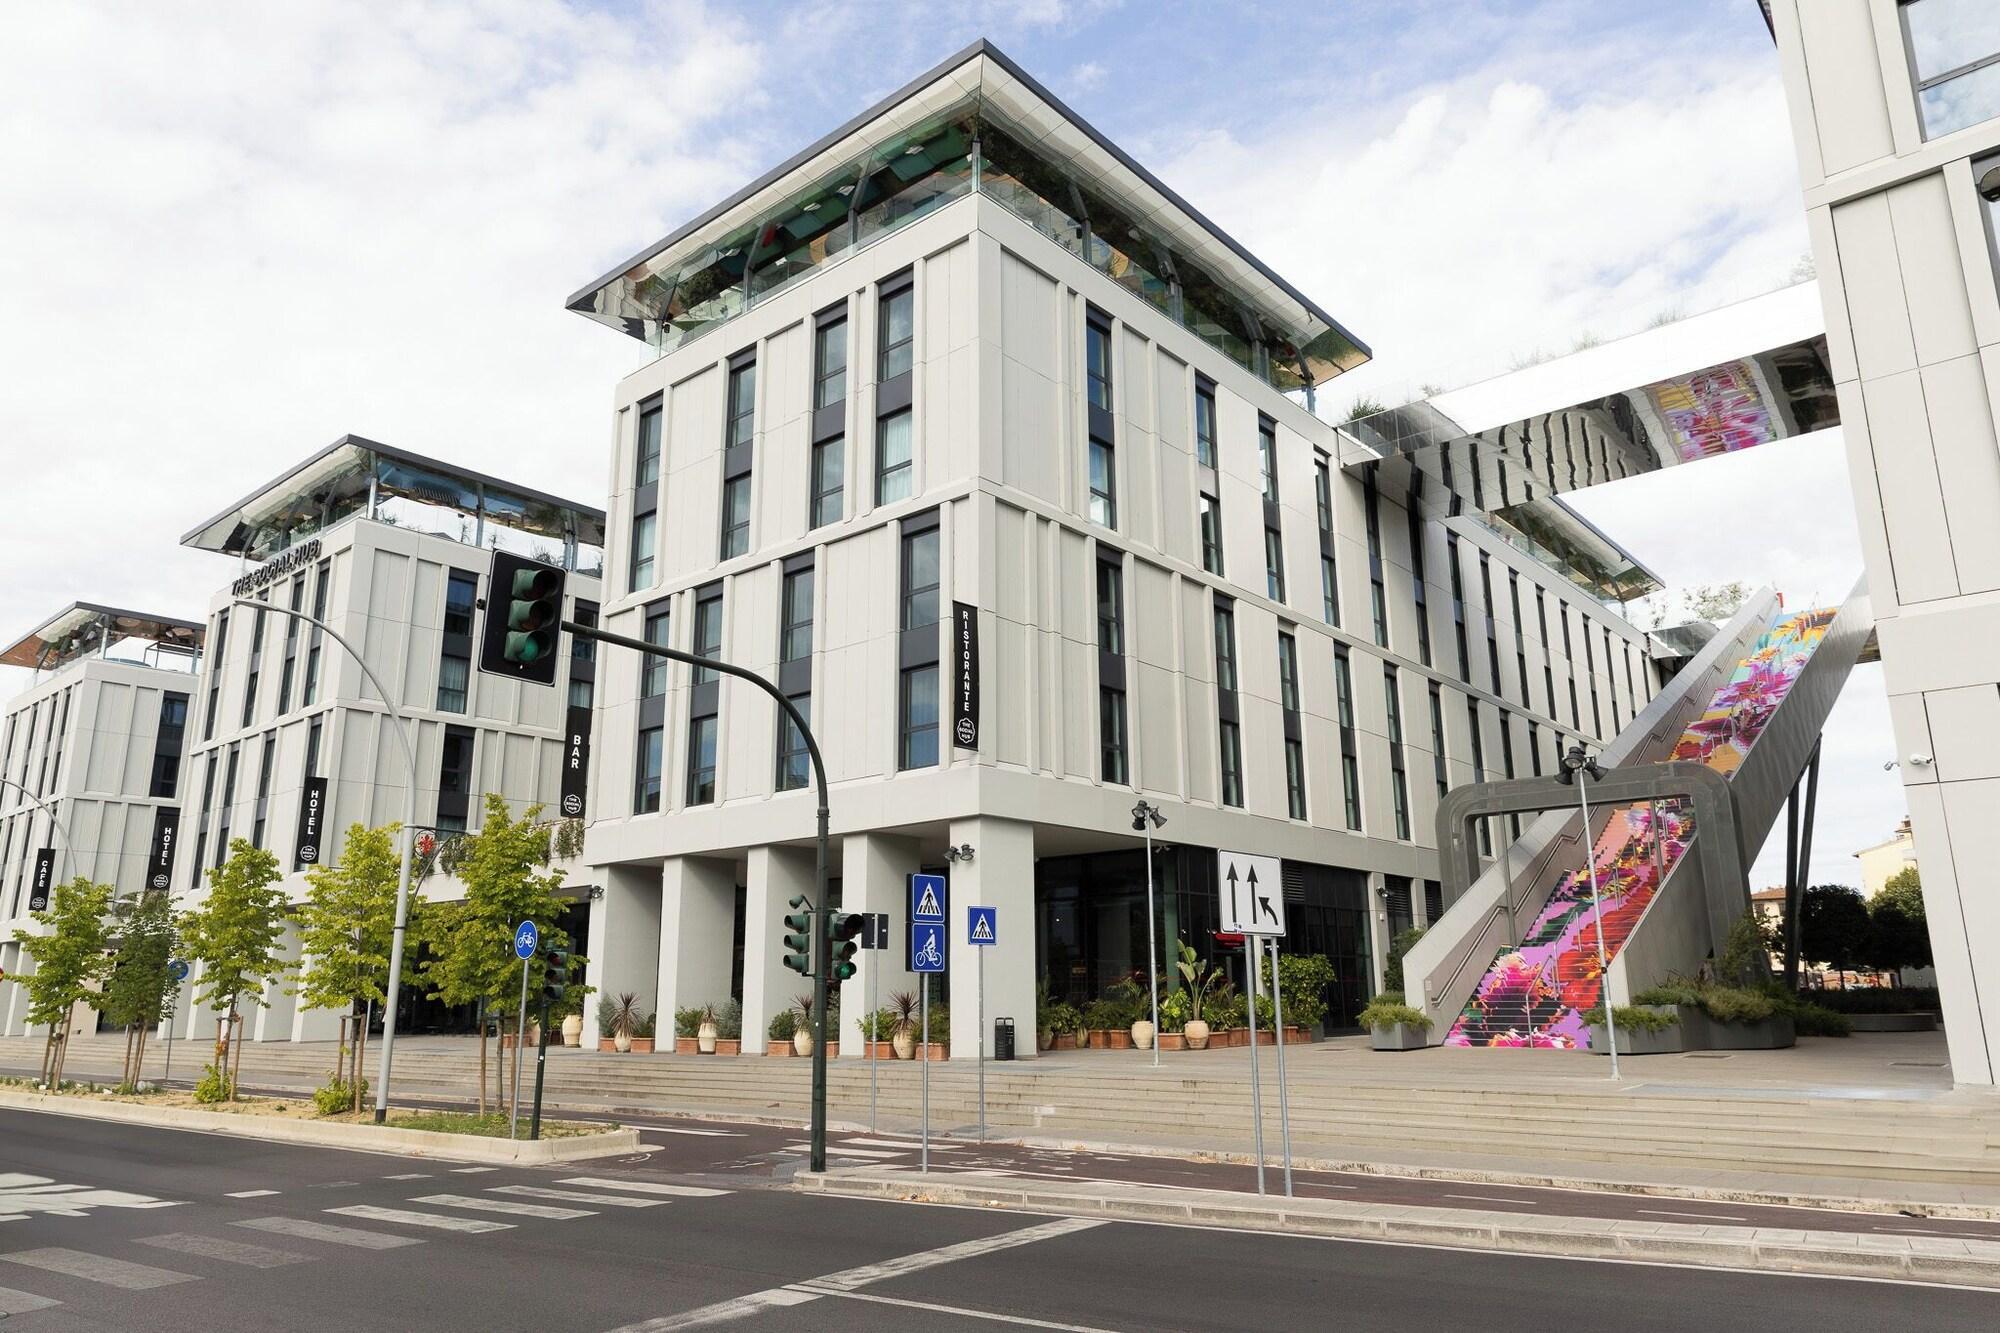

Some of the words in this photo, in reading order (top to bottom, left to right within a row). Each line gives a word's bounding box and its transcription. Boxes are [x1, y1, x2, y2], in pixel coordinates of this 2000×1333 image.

[232, 572, 253, 597] THE
[254, 552, 296, 587] SOCIAL
[294, 539, 320, 566] HUB
[962, 610, 970, 711] RISTORANTE
[571, 734, 581, 769] BAR
[307, 790, 319, 835] HOTEL
[161, 827, 172, 866] HOTEL
